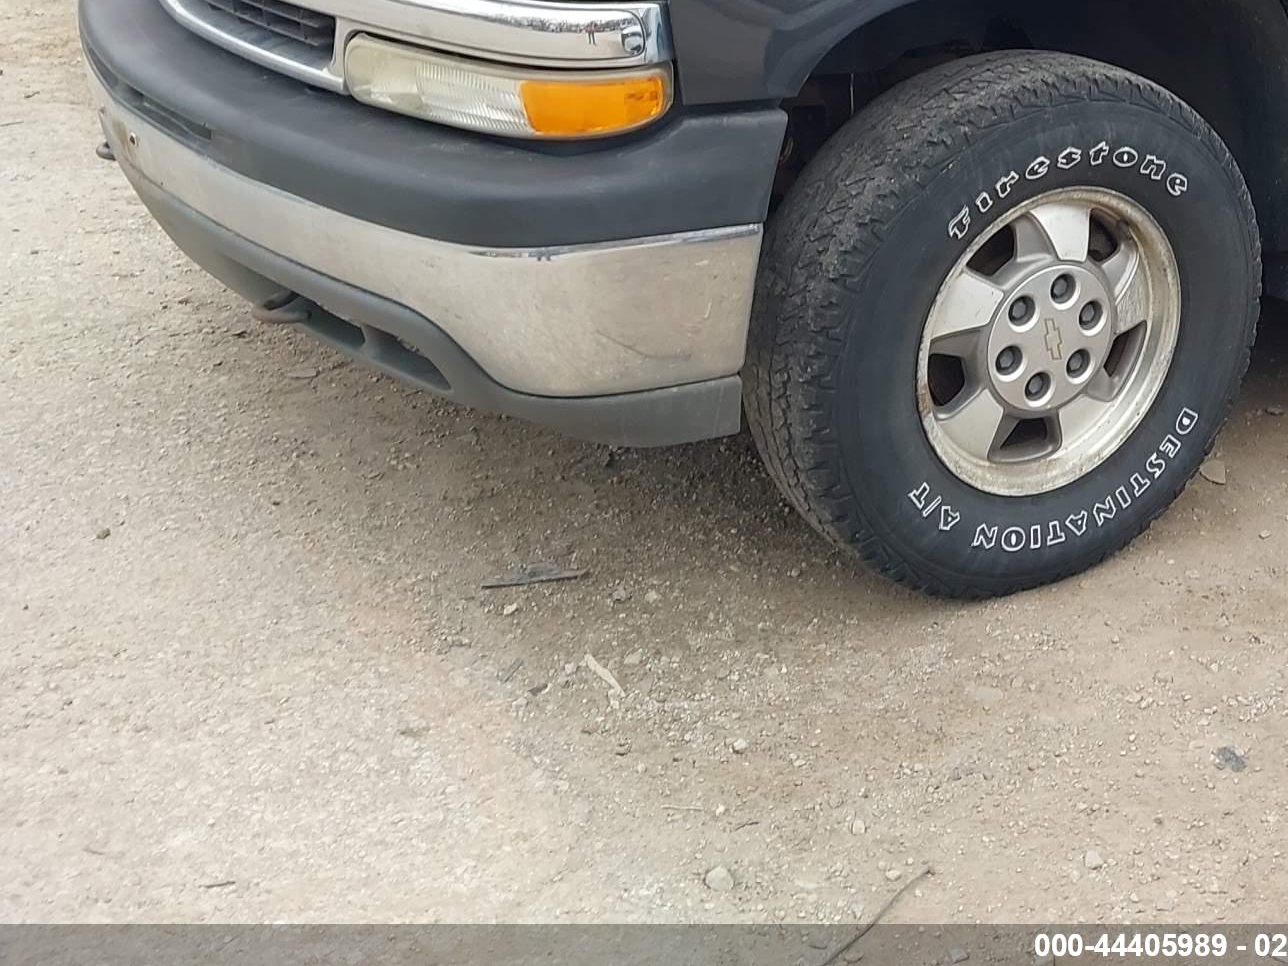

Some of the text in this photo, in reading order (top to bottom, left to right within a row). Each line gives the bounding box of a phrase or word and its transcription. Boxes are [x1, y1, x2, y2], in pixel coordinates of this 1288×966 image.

[947, 141, 1188, 240] Firestone
[908, 408, 1198, 551] DESTINATION A/T
